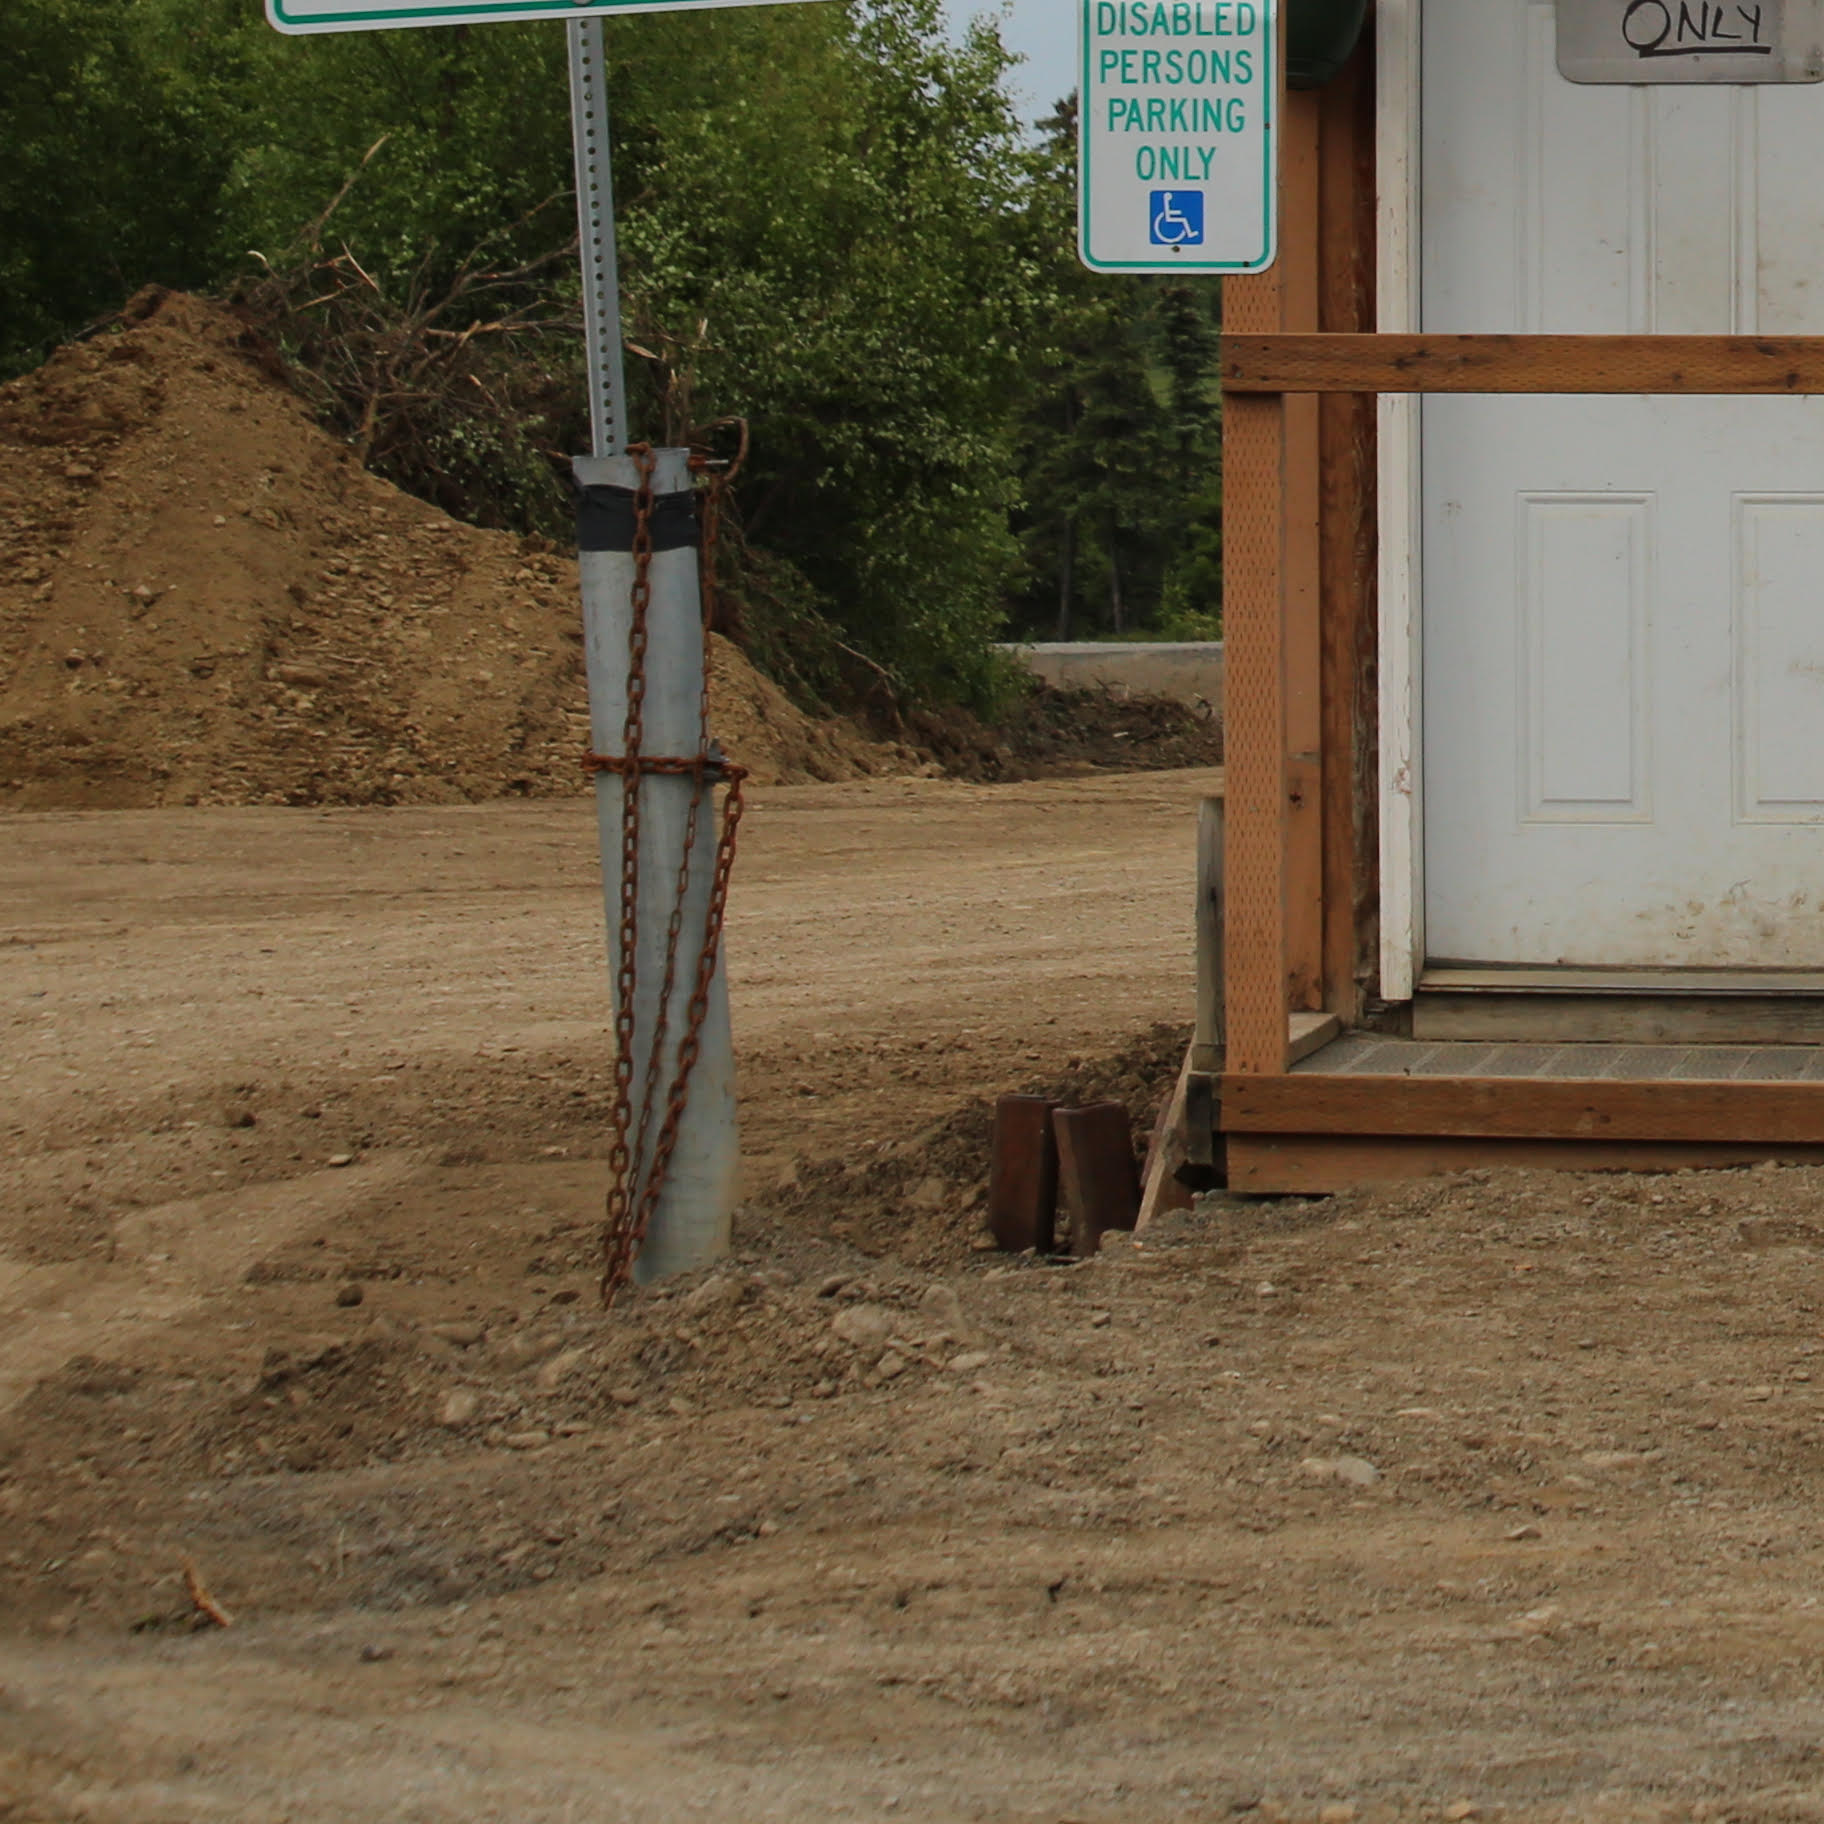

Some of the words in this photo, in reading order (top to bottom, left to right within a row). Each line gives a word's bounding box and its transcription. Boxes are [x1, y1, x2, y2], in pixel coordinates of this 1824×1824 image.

[1097, 2, 1255, 36] DISABLED
[1100, 50, 1252, 84] PERSONS
[1108, 98, 1245, 133] PARKING
[1136, 146, 1216, 180] ONLY
